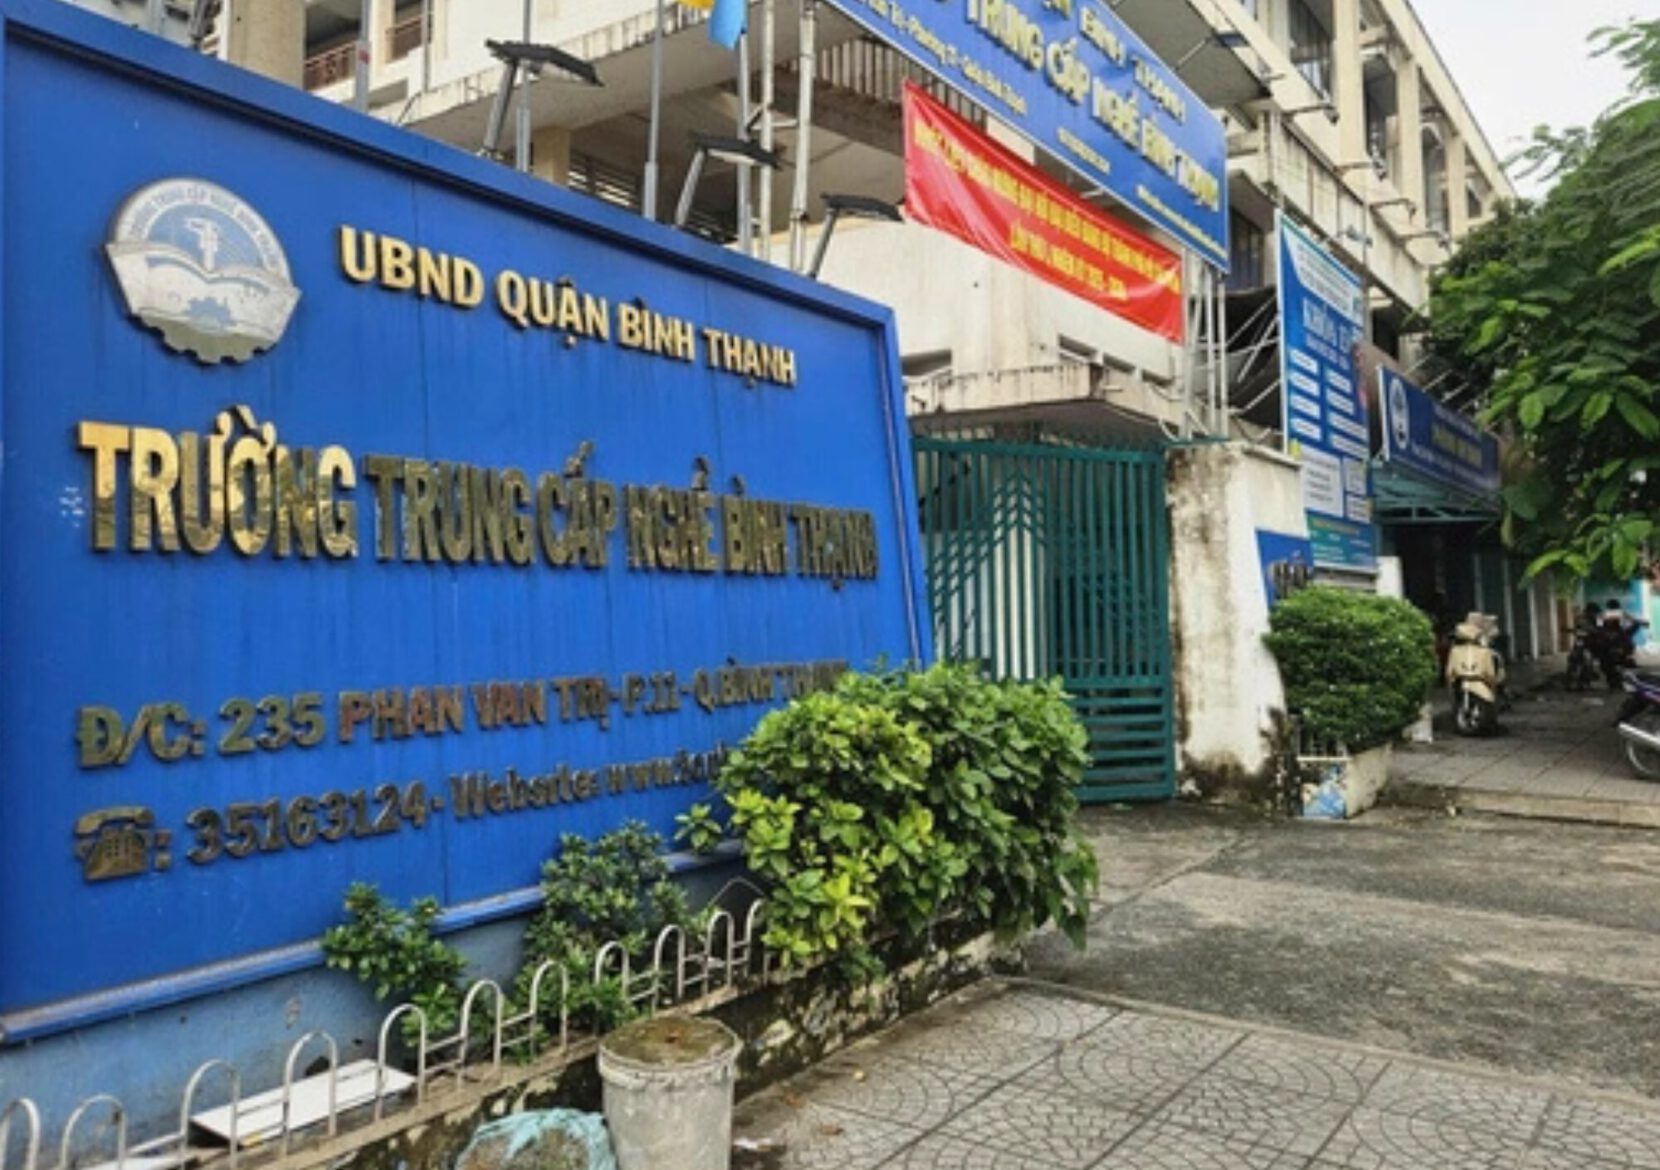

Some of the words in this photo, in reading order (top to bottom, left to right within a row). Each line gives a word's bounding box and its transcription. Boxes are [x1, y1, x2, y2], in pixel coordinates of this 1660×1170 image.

[337, 225, 484, 308] UBND
[496, 268, 610, 347] QUẬN
[618, 298, 696, 362] BÌNH
[703, 327, 797, 388] THẠNH
[77, 404, 358, 557] TRƯỜNG
[362, 455, 534, 565] TRUNG
[537, 441, 617, 568] CẤP
[624, 455, 720, 574] NGHỀ
[722, 475, 787, 577] BÌNH
[76, 701, 205, 768] Đ/C:
[217, 692, 325, 756] 235
[338, 684, 464, 743] PHAN
